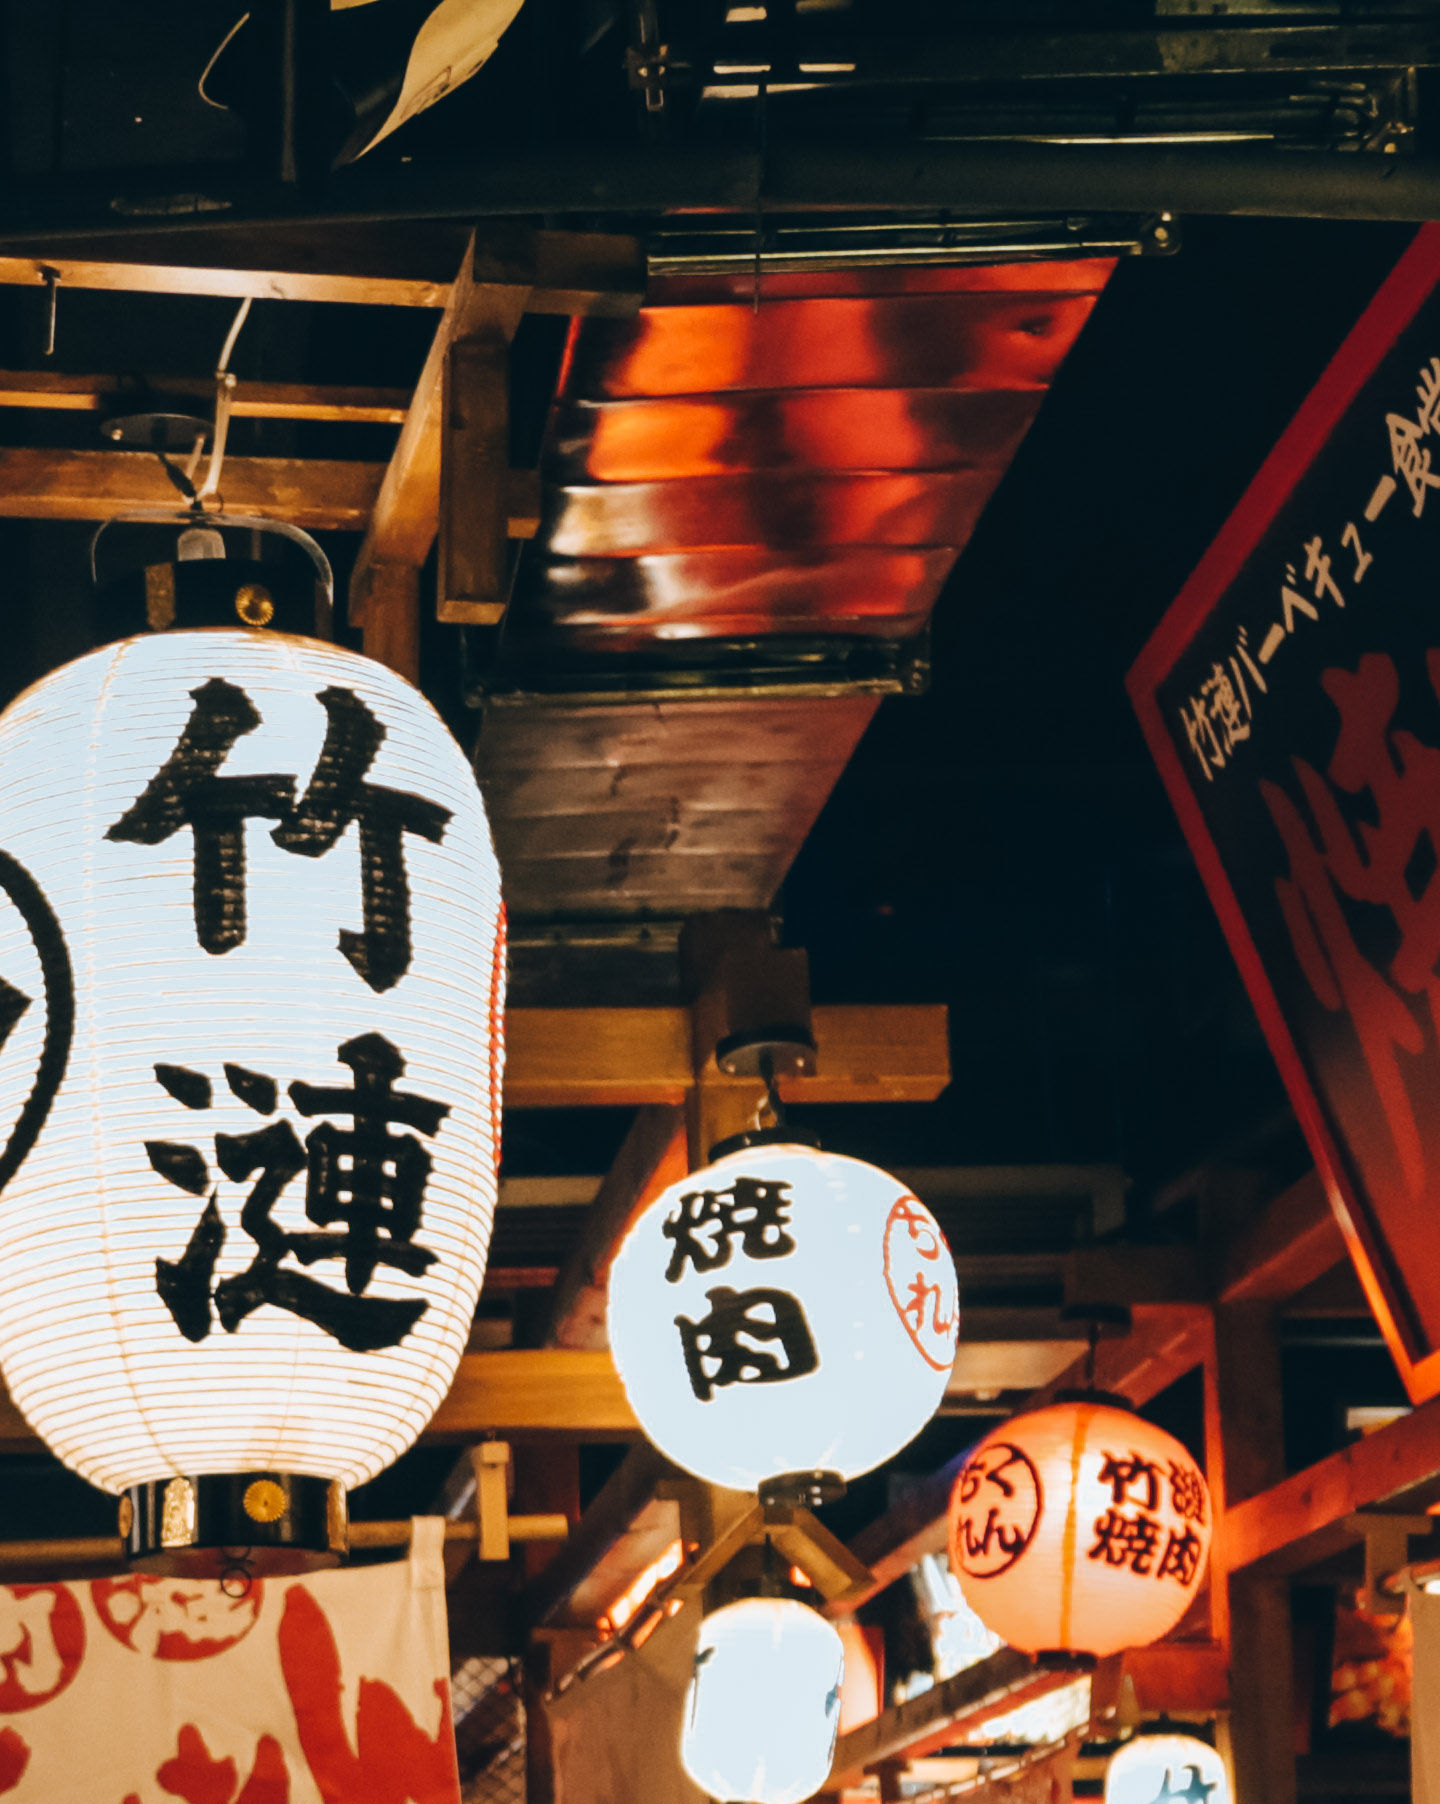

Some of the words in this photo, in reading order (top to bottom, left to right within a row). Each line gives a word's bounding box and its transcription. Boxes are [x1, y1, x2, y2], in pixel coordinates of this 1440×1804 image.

[102, 677, 455, 1353] 竹漣
[661, 1175, 821, 1403] 焼肉
[1086, 1507, 1203, 1588] 焼肉
